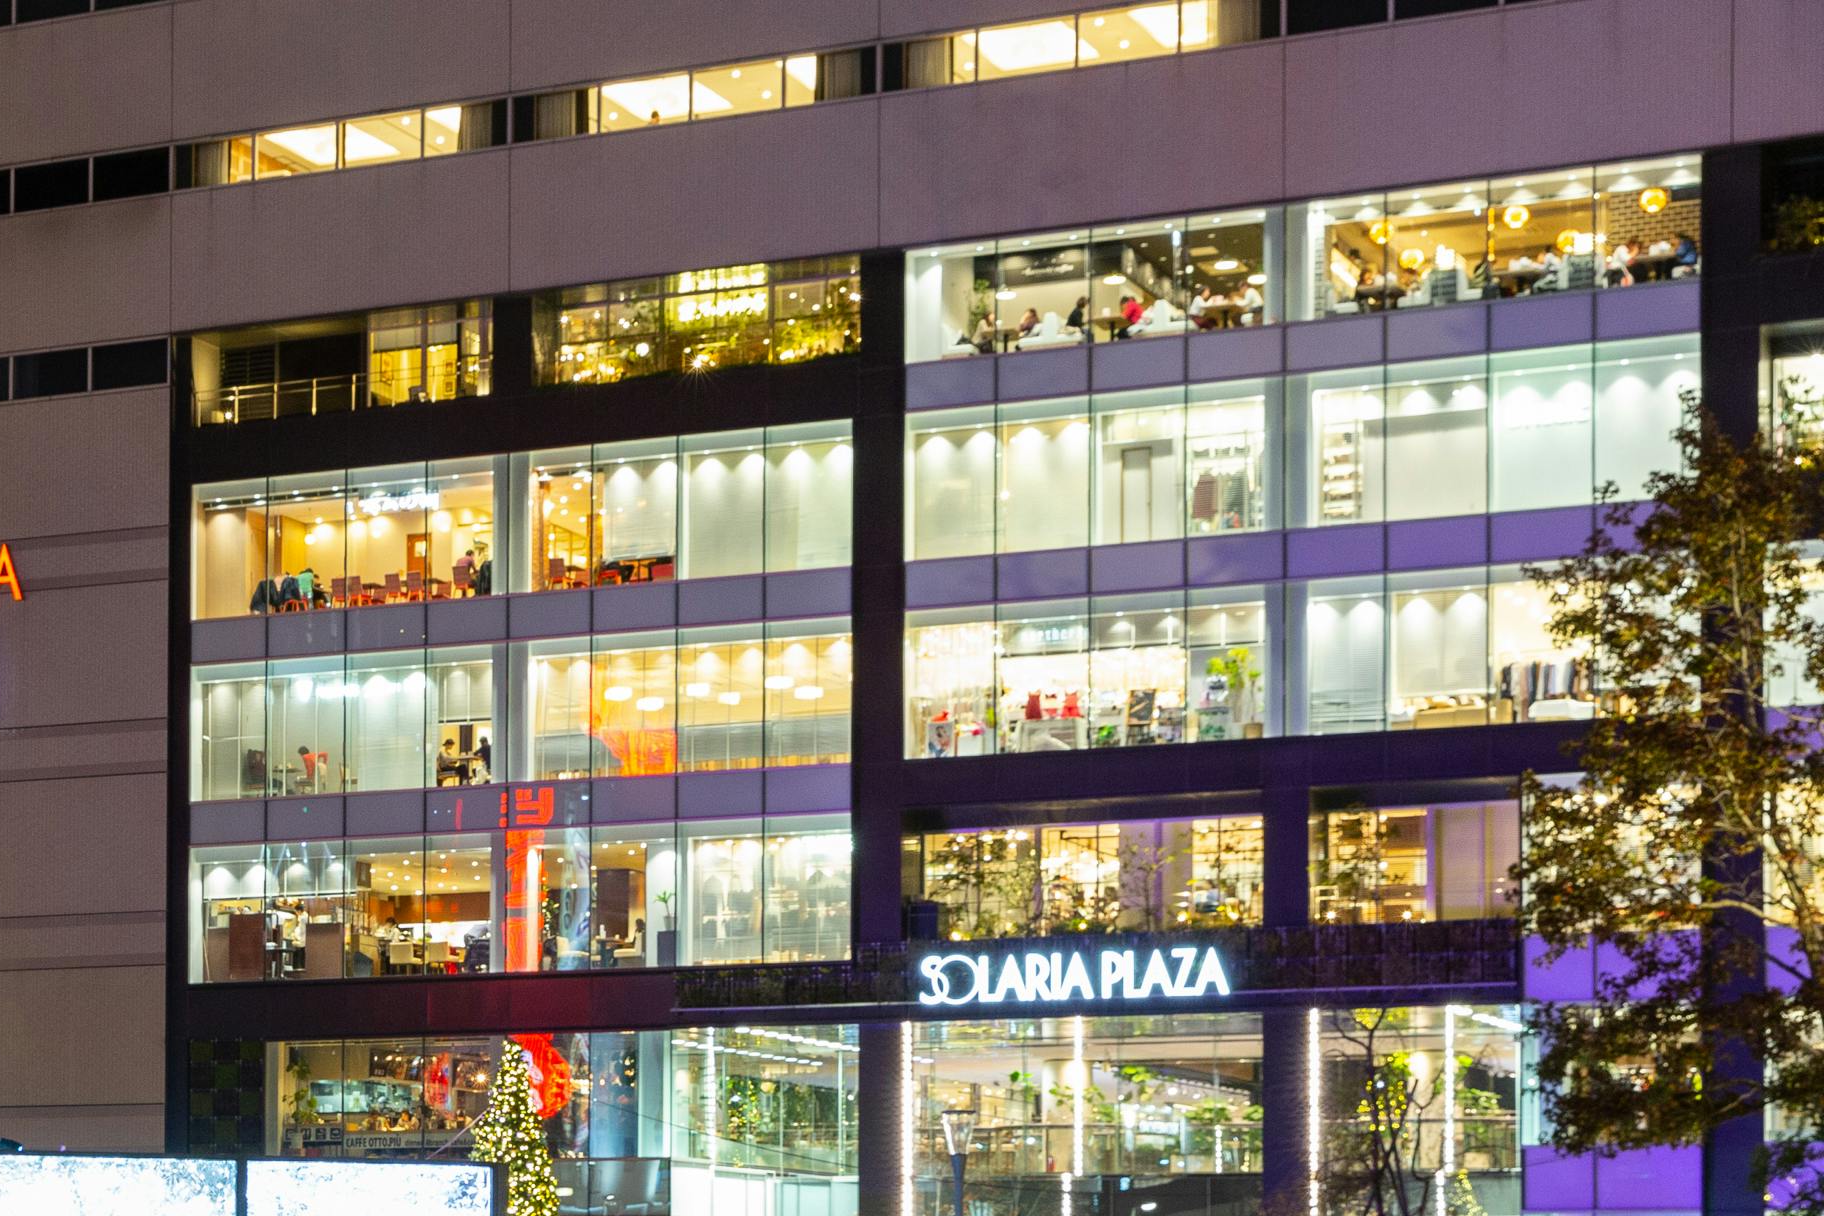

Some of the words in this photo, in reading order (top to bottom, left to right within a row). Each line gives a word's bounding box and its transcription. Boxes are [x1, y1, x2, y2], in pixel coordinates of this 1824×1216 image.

[918, 950, 1094, 1006] SOLARIA
[1101, 946, 1231, 1000] PLAZA
[345, 1138, 367, 1148] CAFFE
